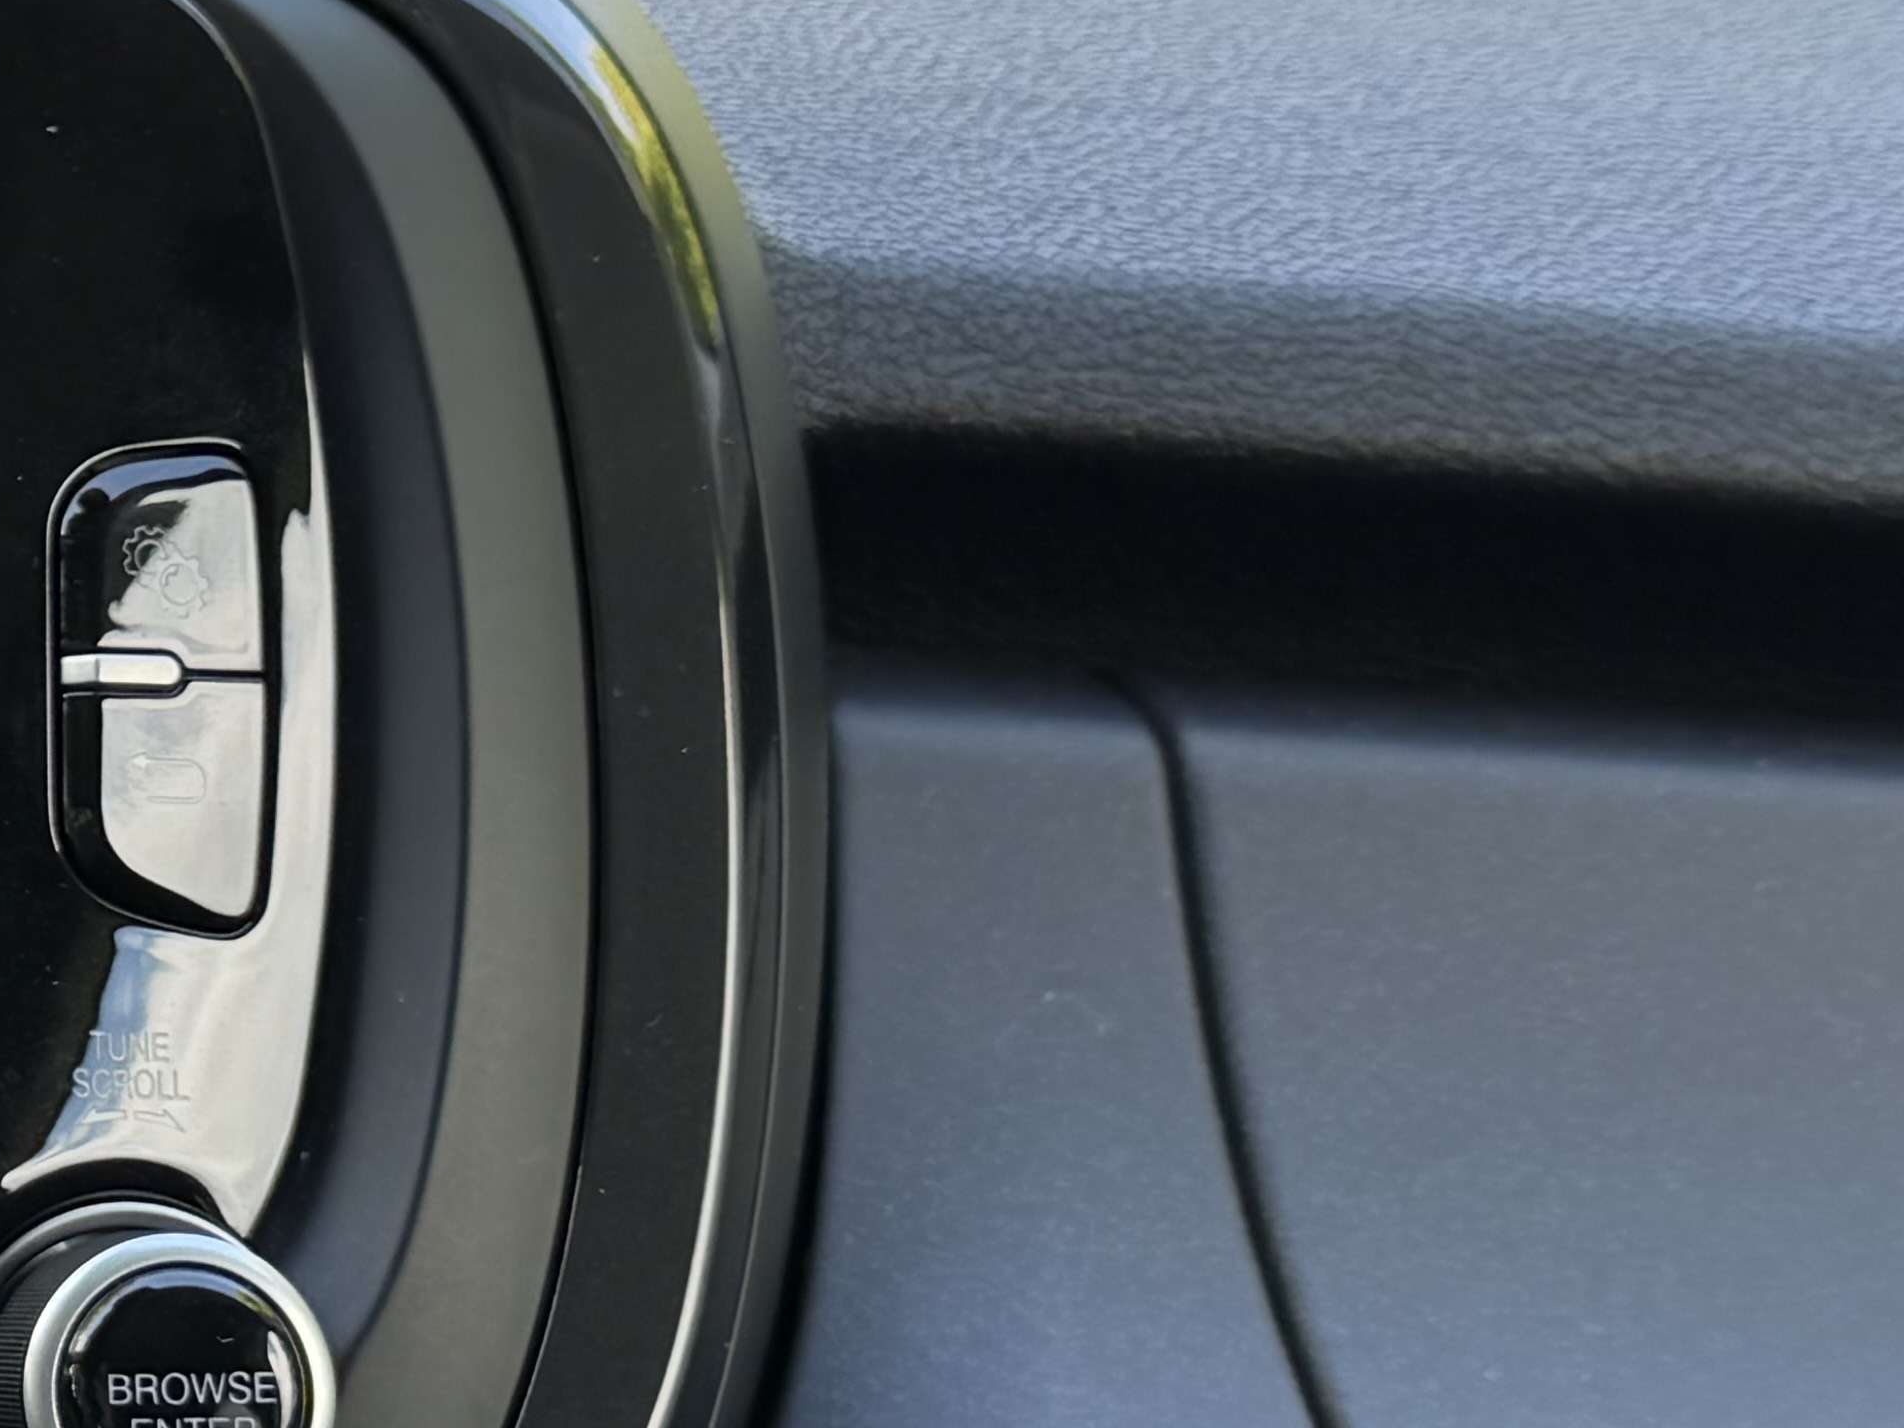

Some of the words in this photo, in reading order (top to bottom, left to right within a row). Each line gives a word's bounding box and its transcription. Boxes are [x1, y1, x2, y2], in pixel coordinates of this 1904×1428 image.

[89, 1029, 171, 1063] TUNE
[72, 1067, 191, 1102] SCROLL
[107, 1370, 278, 1406] BROWSE
